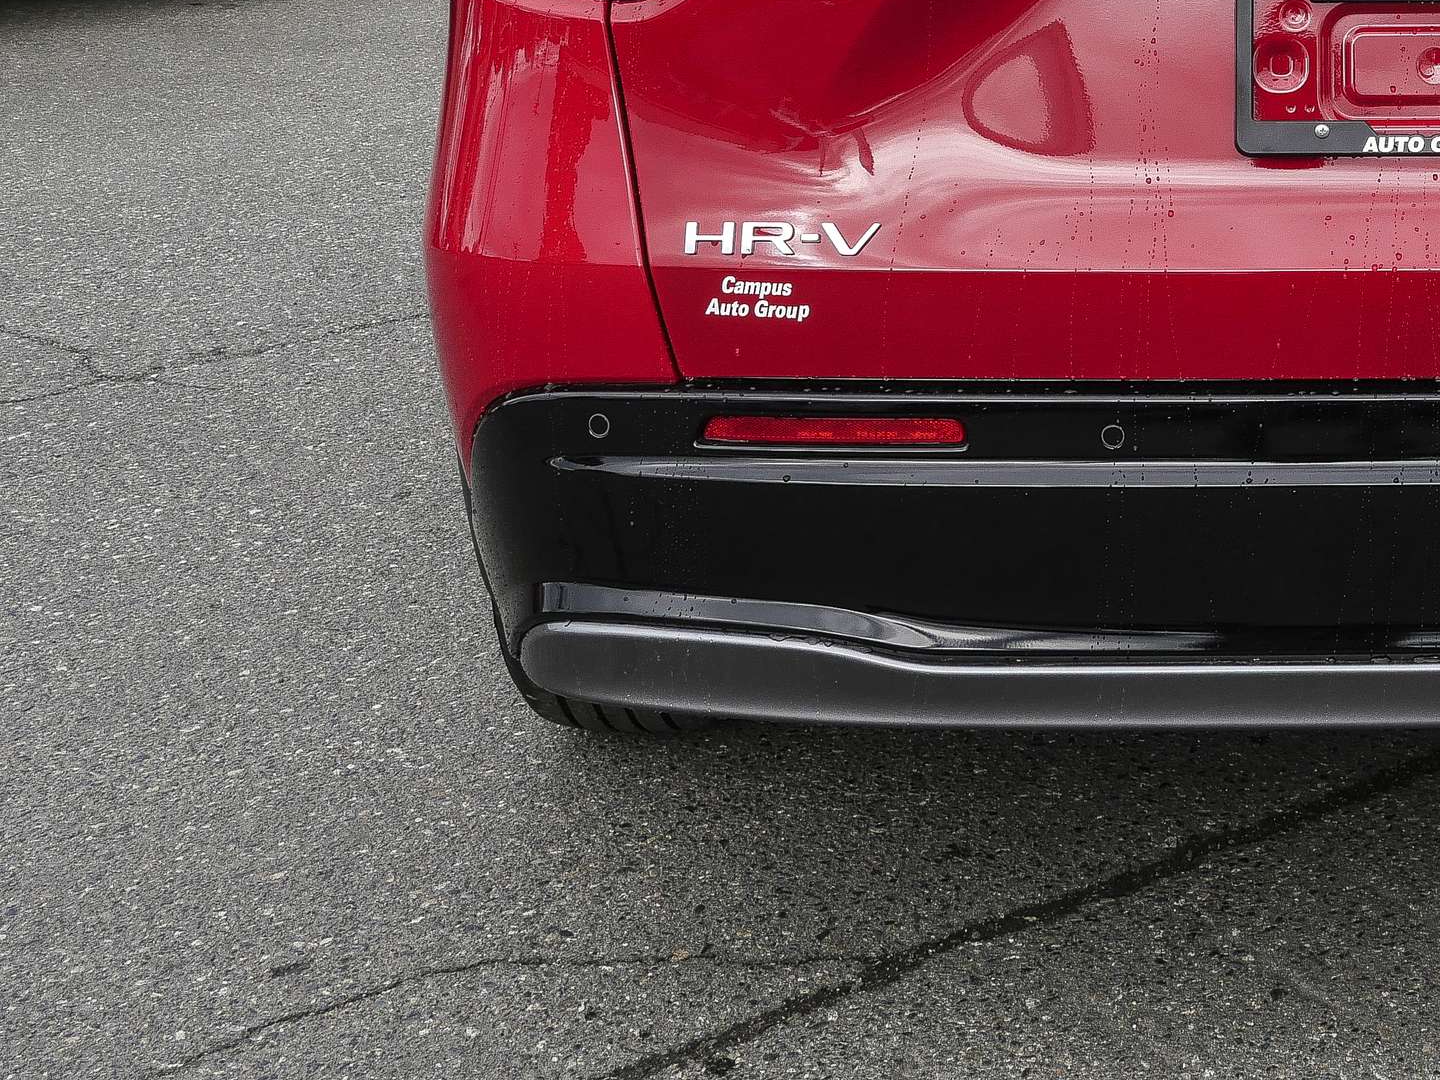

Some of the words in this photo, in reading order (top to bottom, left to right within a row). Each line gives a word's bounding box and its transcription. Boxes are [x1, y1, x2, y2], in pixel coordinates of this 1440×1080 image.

[1363, 136, 1426, 153] AUTO
[684, 221, 882, 256] HR-V
[722, 276, 793, 299] Campus
[705, 298, 750, 318] Auto
[754, 299, 810, 322] Group
